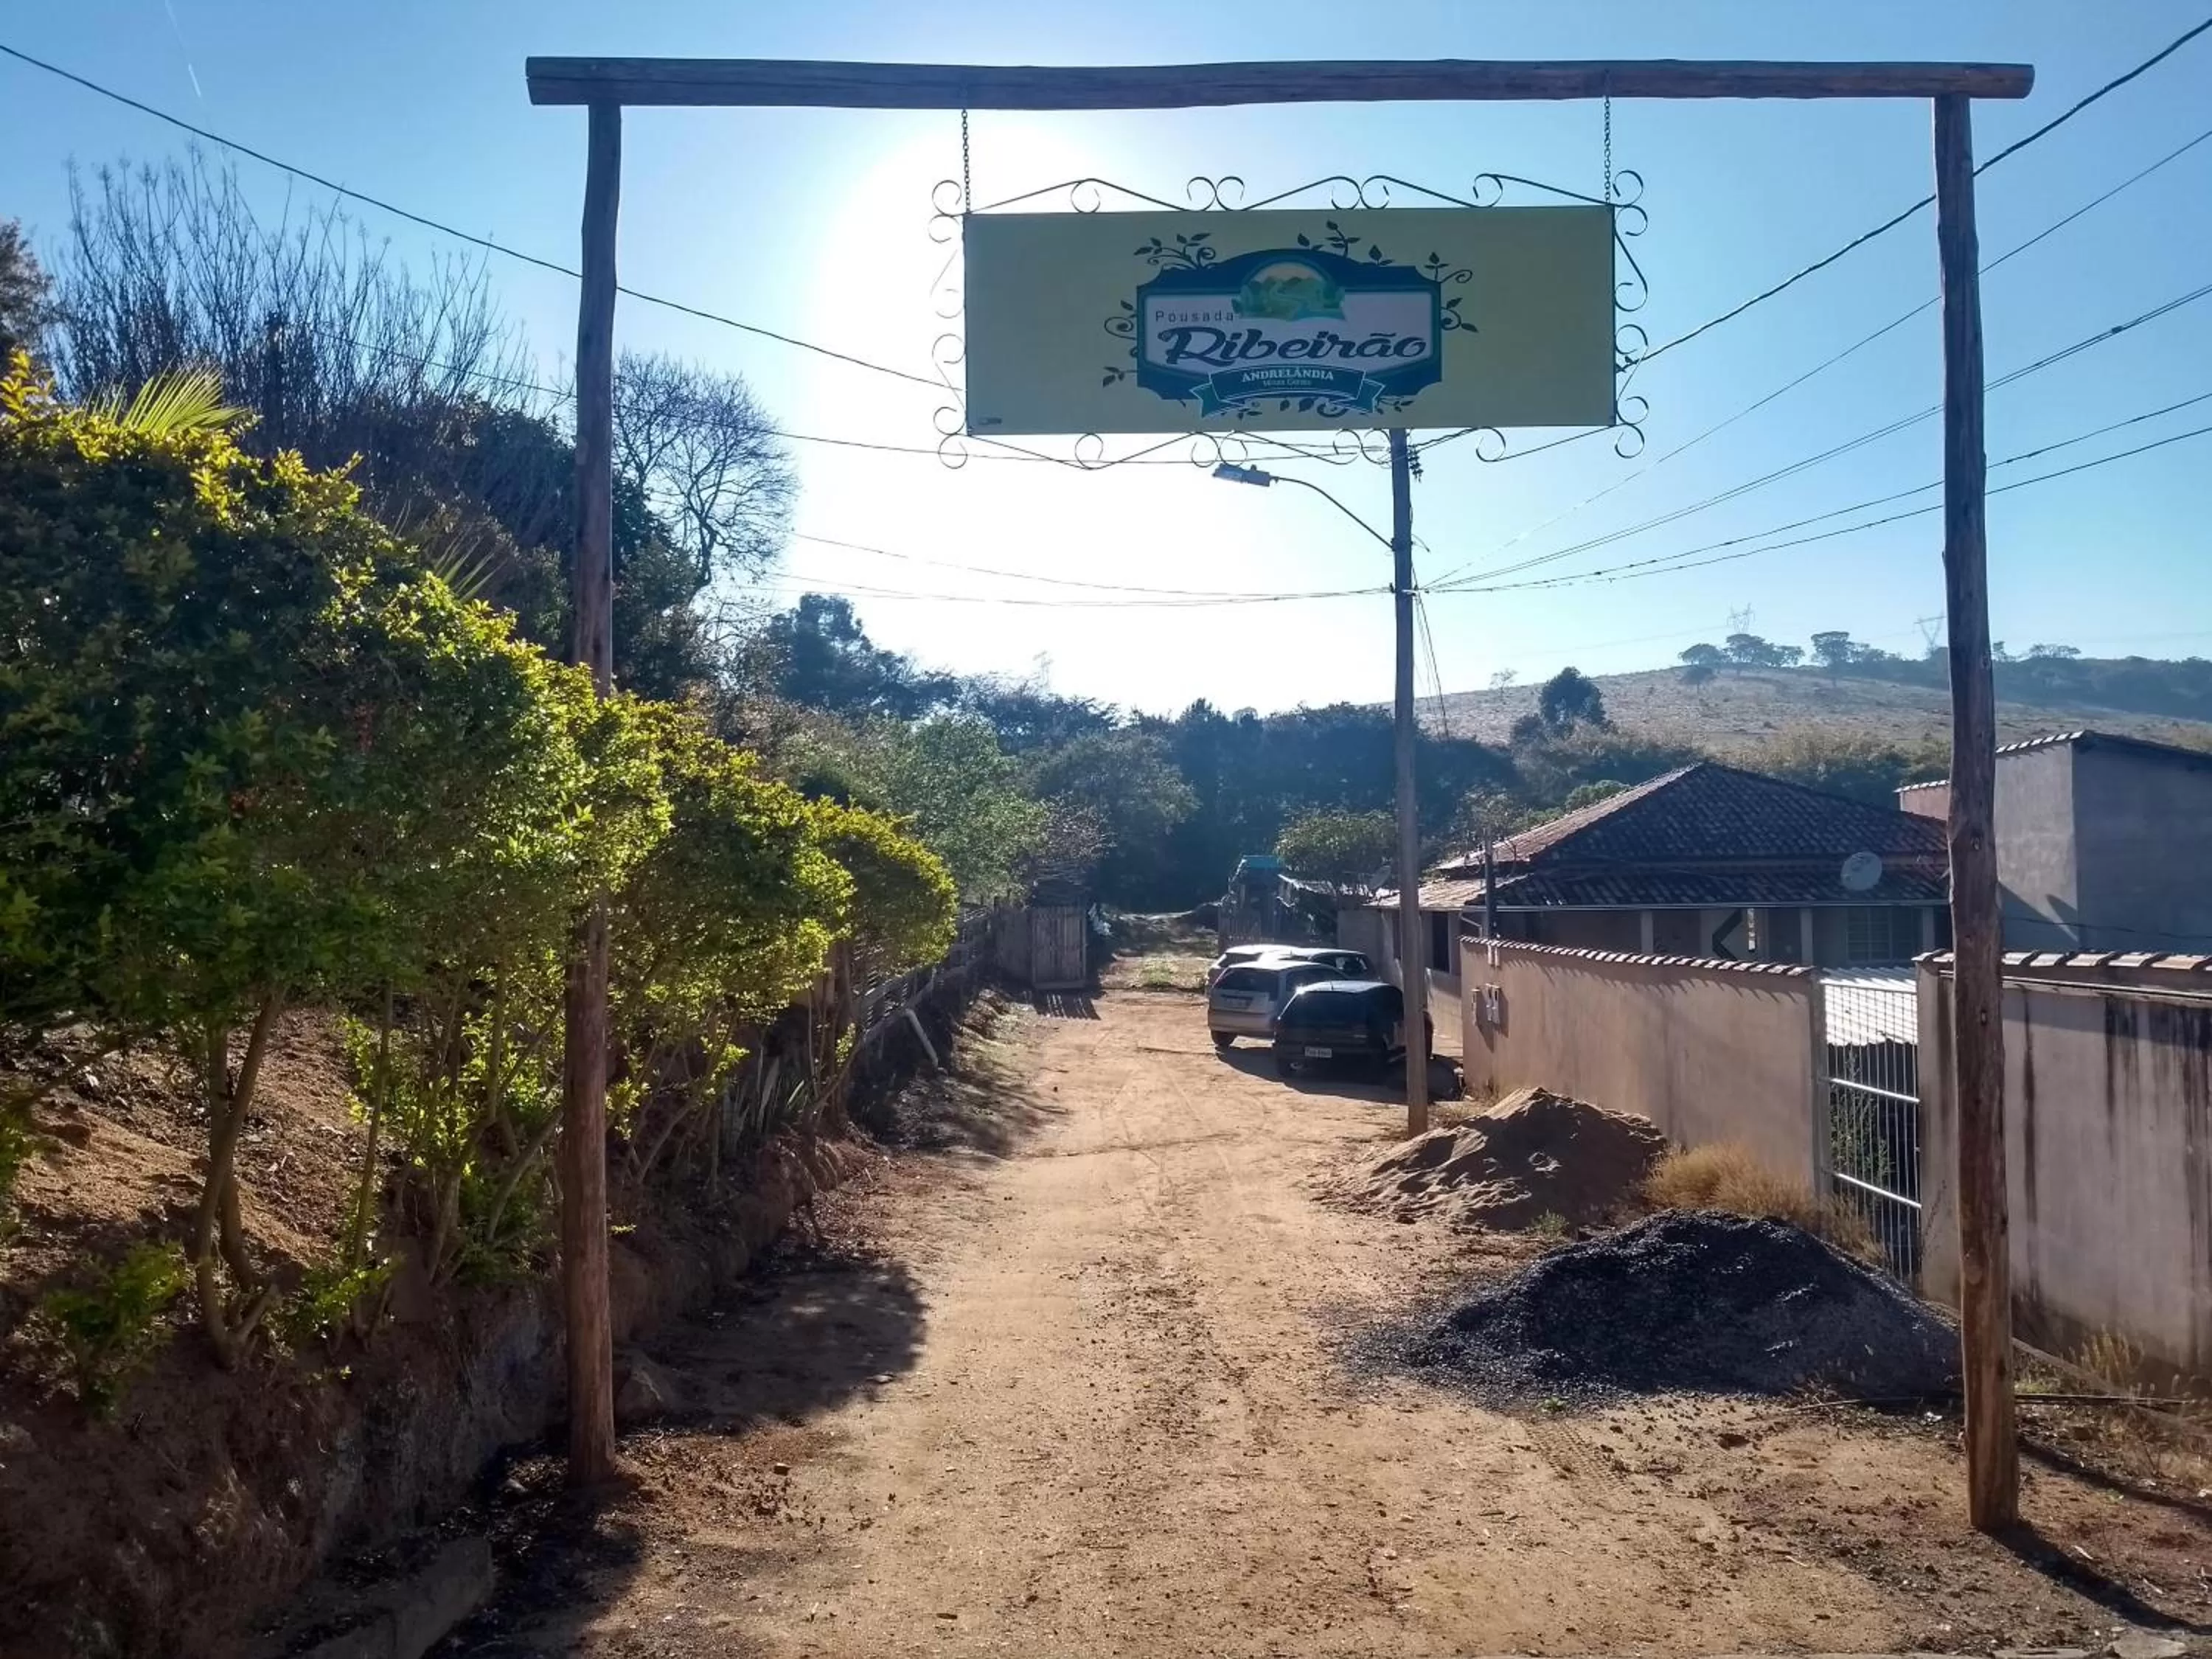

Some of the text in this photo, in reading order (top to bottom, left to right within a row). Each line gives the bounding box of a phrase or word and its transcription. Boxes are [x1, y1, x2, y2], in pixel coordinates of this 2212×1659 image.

[1155, 310, 1234, 323] Pousada
[1157, 327, 1427, 367] Ribeirão
[1242, 367, 1334, 383] ANDRELÂNDIA
